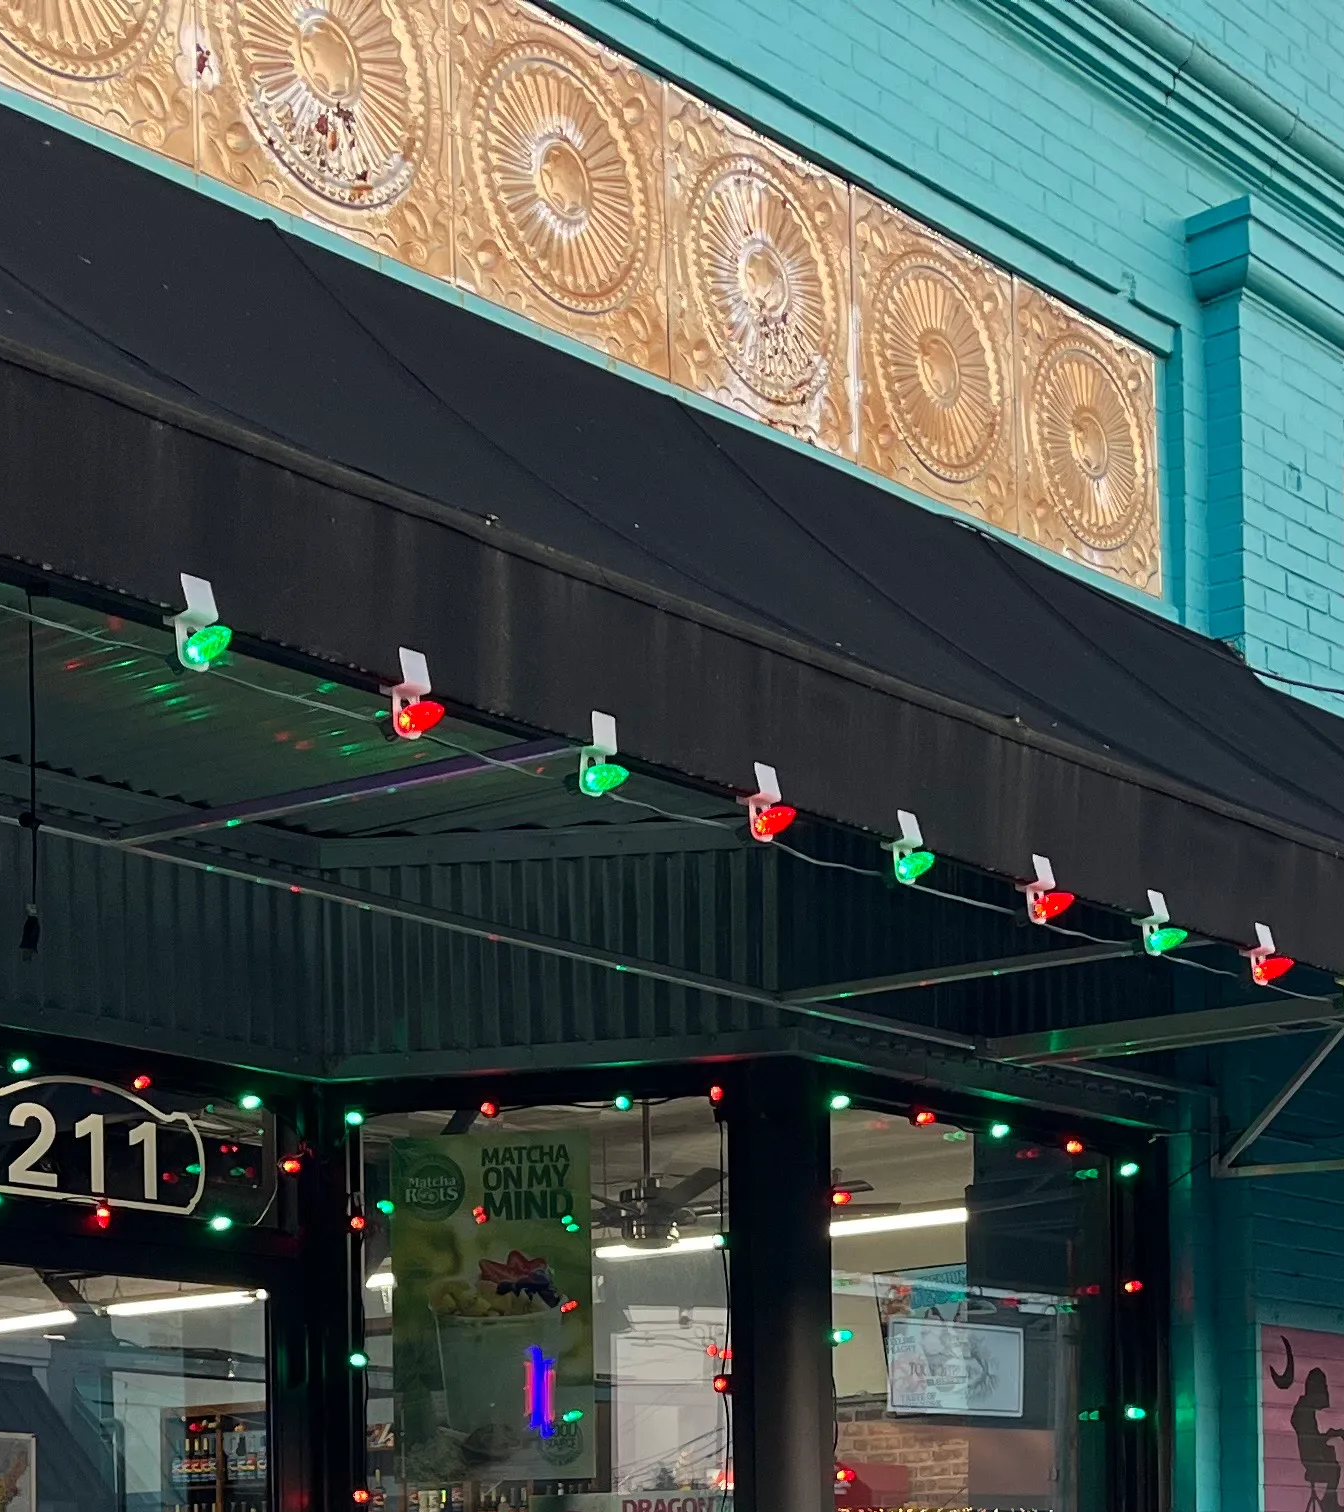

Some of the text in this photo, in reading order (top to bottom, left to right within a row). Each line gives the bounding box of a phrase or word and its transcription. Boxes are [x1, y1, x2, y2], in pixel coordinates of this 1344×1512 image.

[8, 1102, 157, 1200] 211
[481, 1144, 570, 1167] MATCHA
[408, 1176, 456, 1188] Matcha
[483, 1163, 570, 1191] ON MY
[483, 1189, 574, 1221] MIND
